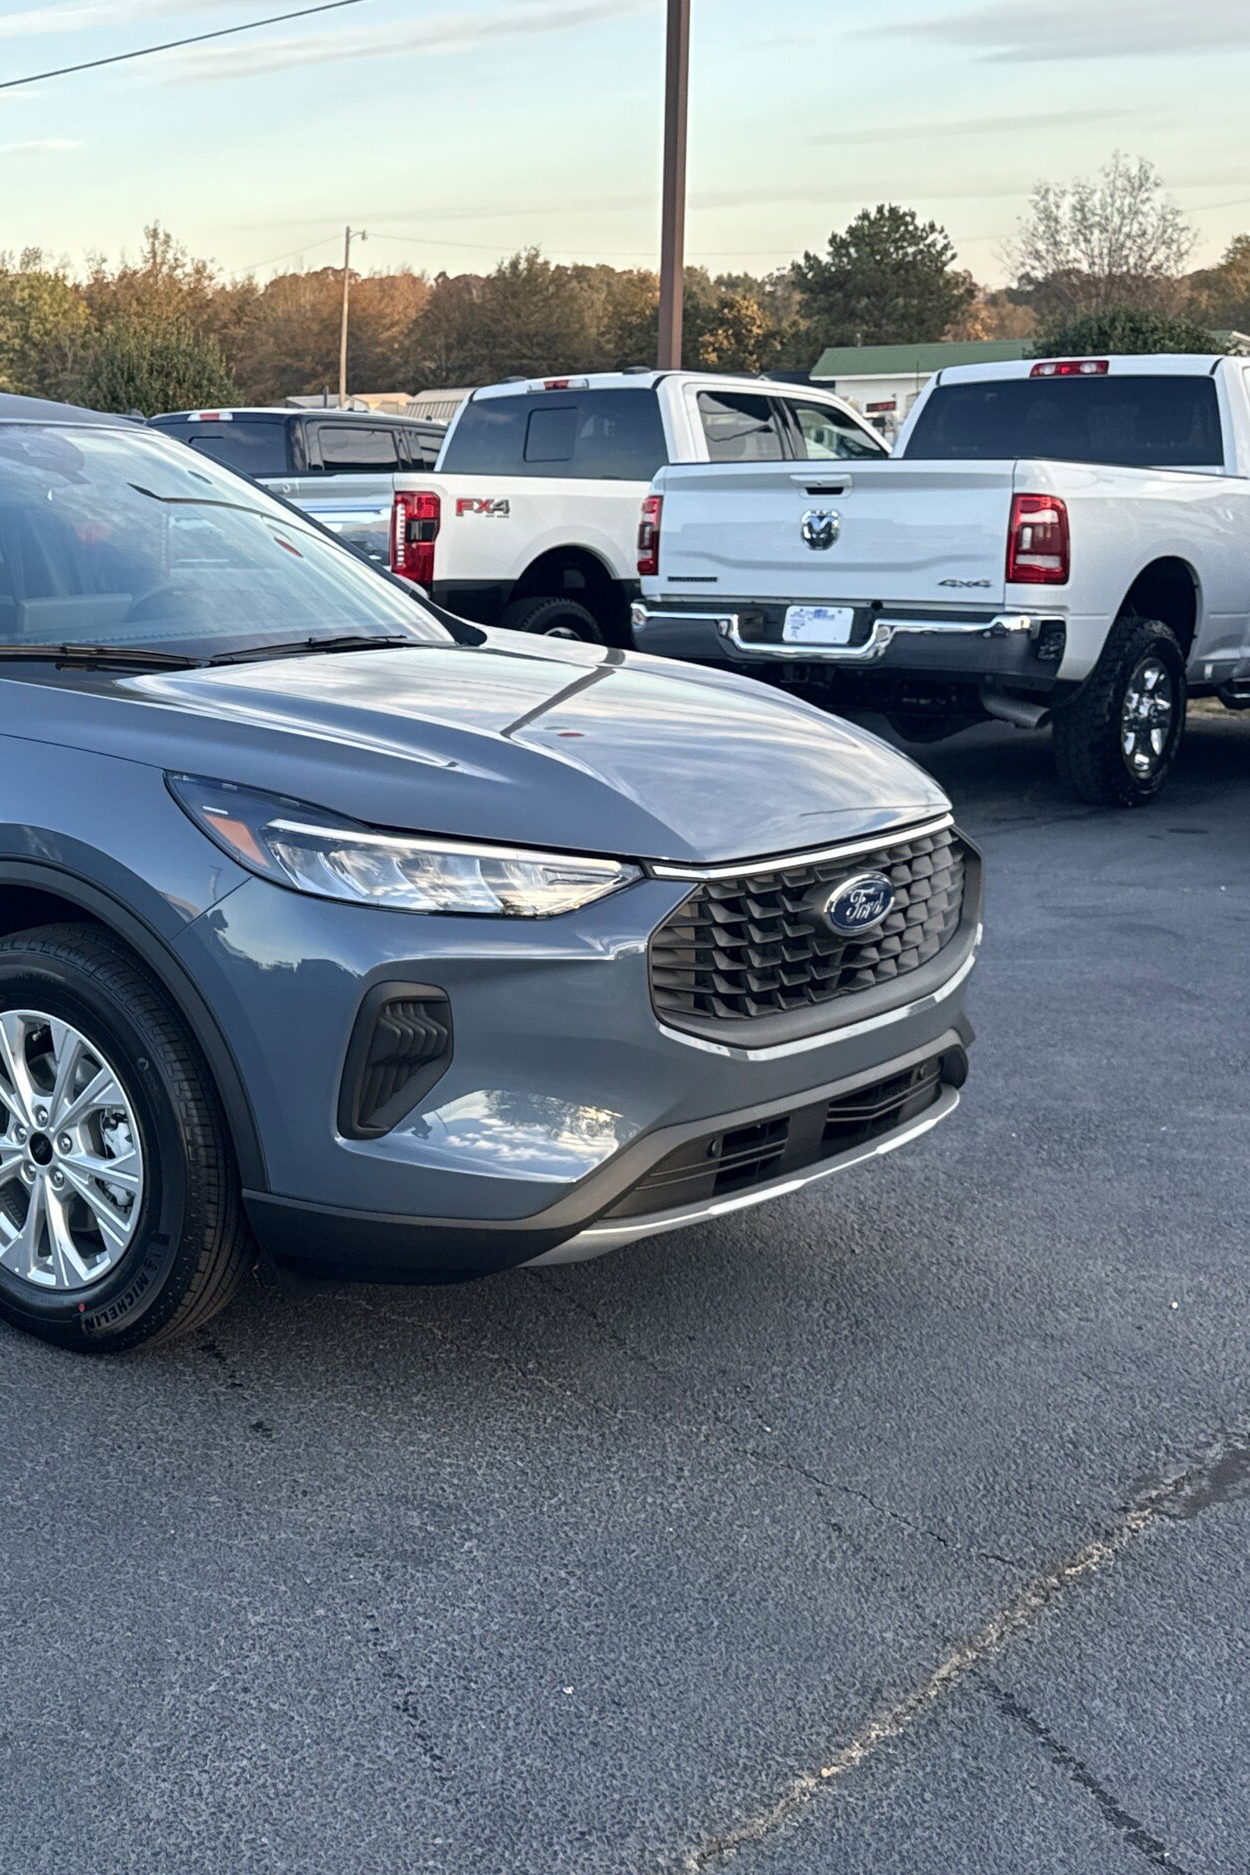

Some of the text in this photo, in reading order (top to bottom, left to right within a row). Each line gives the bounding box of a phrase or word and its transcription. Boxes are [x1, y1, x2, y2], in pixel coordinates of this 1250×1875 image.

[455, 498, 510, 517] FX4
[846, 887, 884, 922] Ford
[84, 1271, 151, 1333] MICHELIN
